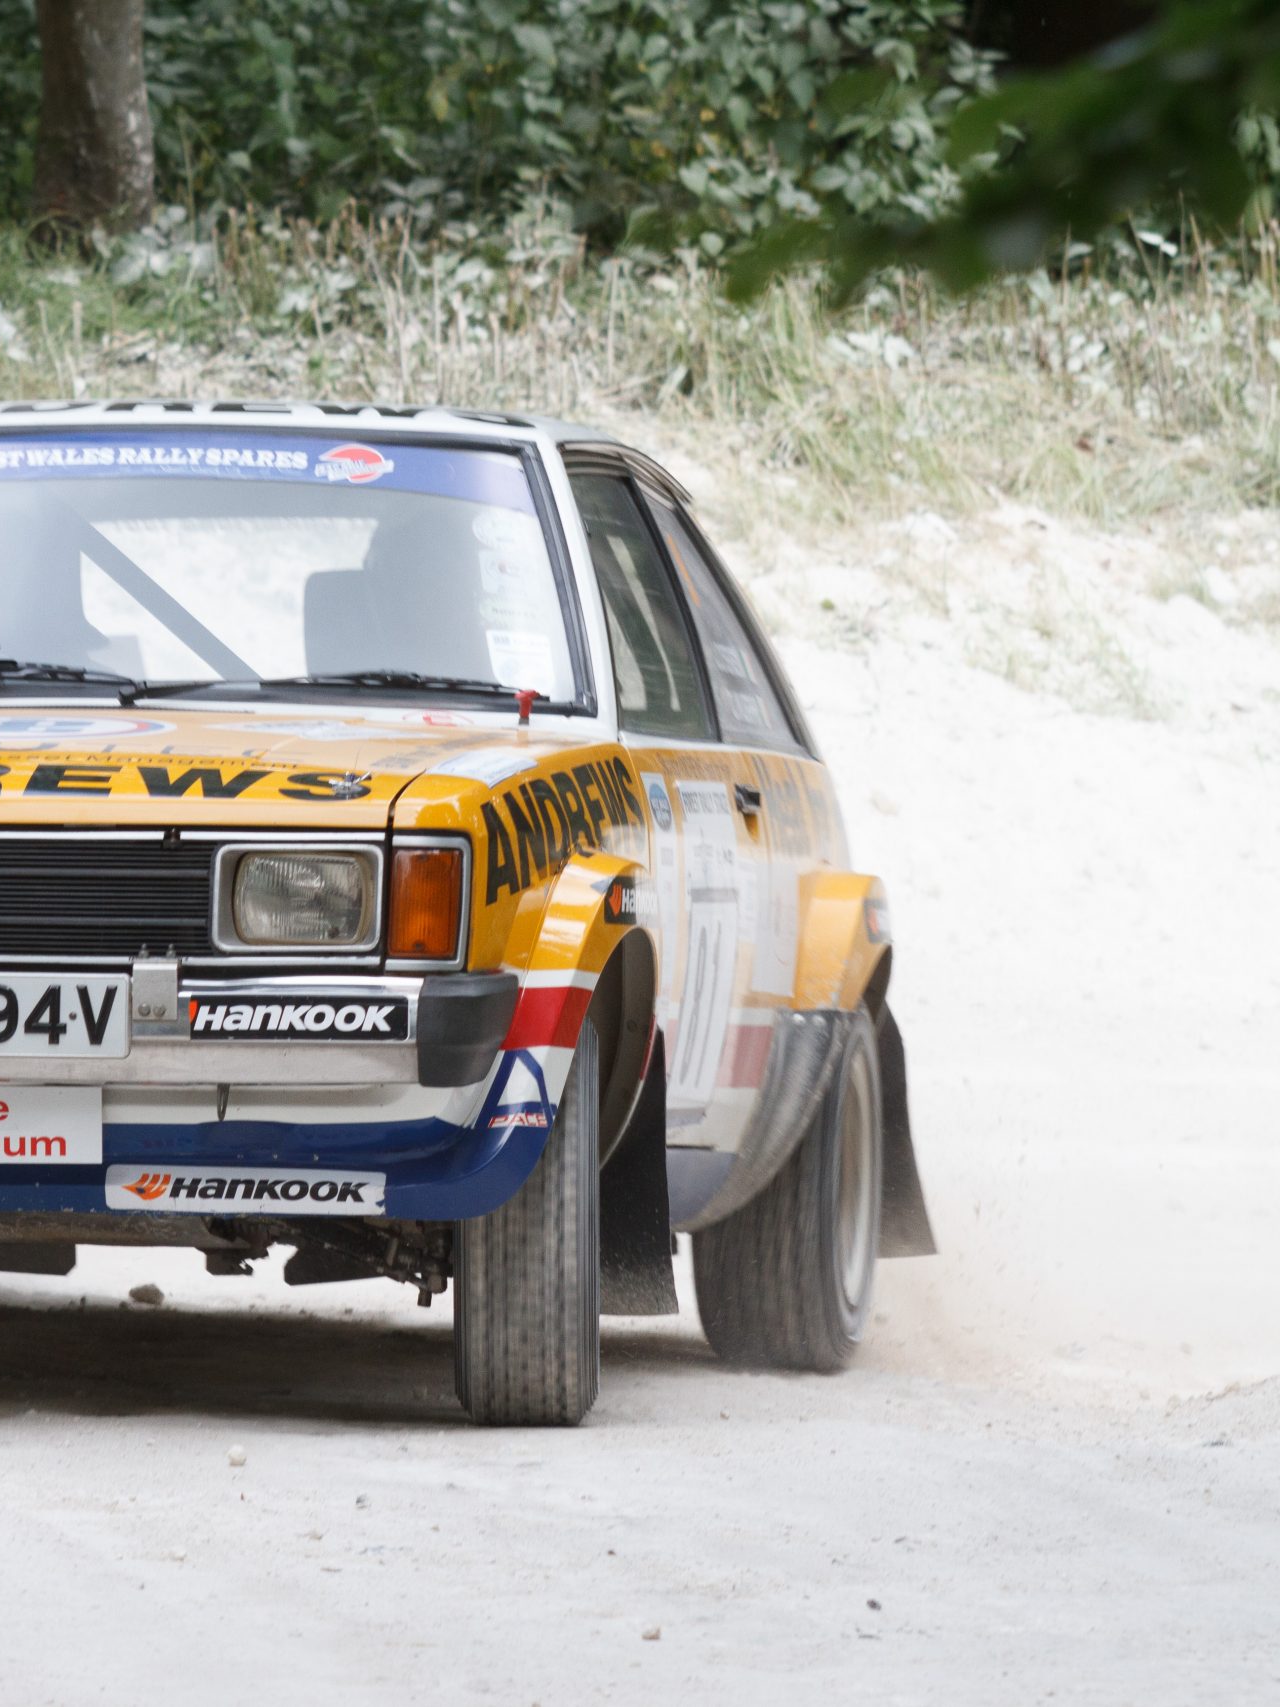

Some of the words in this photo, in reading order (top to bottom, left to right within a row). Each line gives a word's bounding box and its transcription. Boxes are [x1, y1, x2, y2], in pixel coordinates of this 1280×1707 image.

[26, 447, 113, 468] WALES
[116, 446, 206, 466] RALLY
[205, 448, 308, 470] SPARES
[480, 756, 648, 906] ANDREWS
